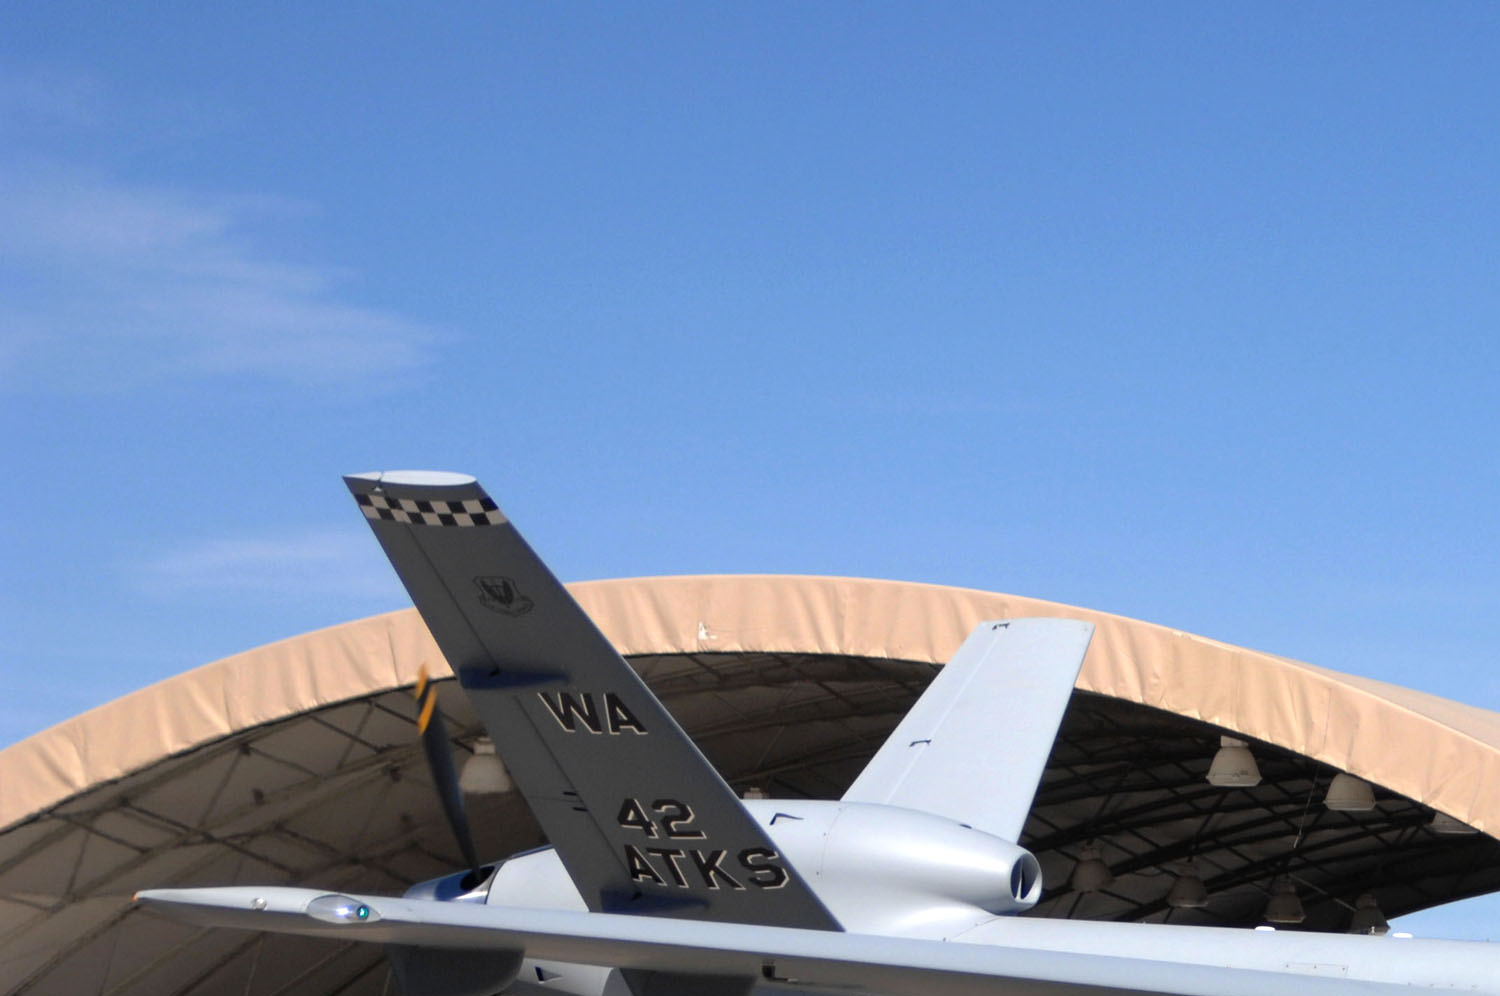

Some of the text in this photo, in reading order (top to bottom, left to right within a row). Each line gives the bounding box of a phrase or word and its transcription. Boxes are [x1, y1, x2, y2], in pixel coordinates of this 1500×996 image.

[537, 692, 648, 735] WA
[617, 798, 707, 839] 42
[624, 844, 789, 890] ATKS
